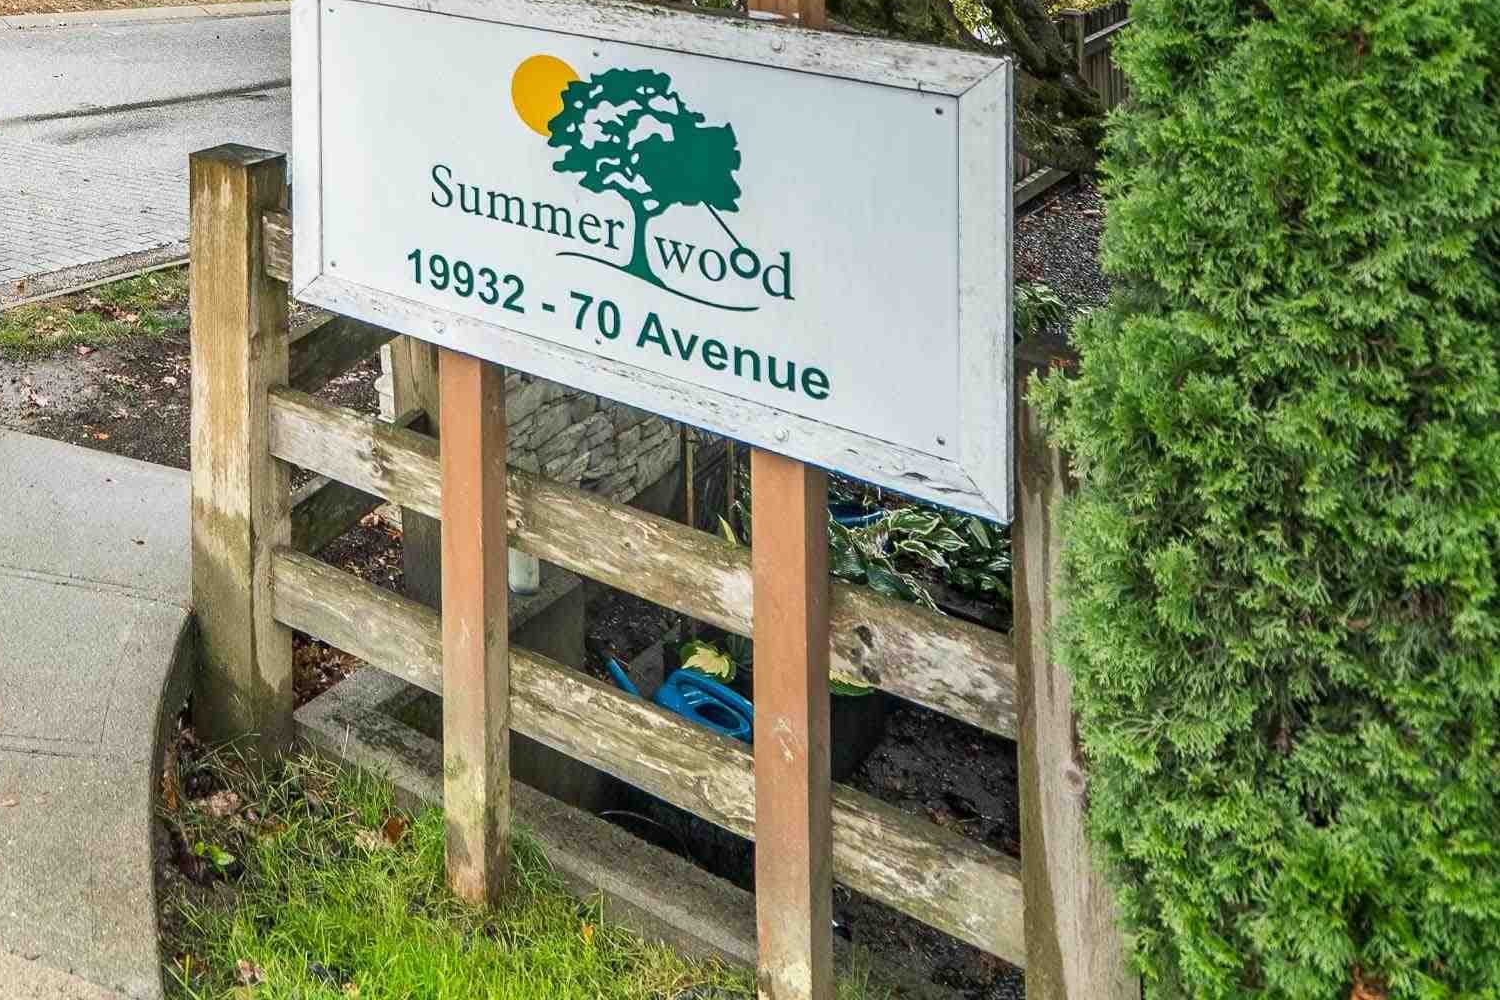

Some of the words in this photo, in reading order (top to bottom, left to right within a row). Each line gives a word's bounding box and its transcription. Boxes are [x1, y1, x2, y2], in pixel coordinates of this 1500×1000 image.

[407, 248, 525, 314] 19932
[541, 302, 556, 313] -
[570, 290, 621, 340] 70
[635, 311, 830, 400] Avenue
